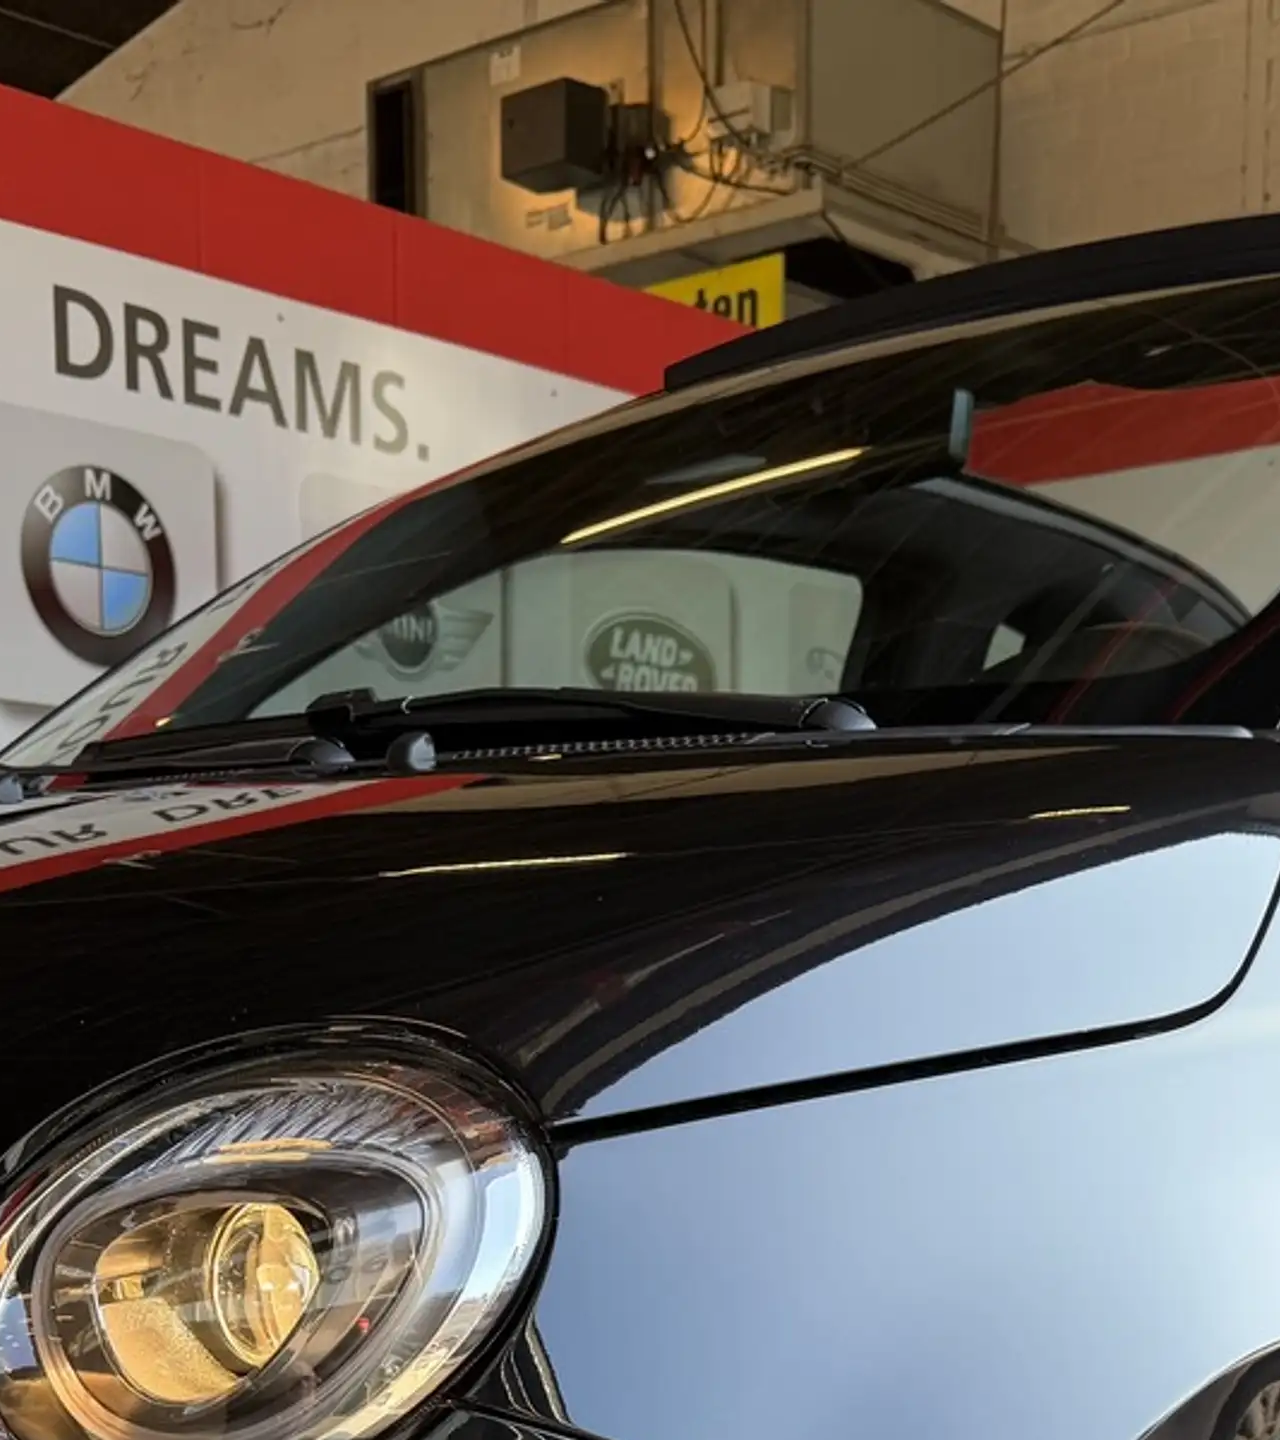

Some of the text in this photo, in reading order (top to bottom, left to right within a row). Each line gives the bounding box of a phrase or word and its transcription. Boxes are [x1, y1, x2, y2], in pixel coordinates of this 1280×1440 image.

[51, 283, 431, 461] DREAMS.
[34, 468, 162, 542] BMW
[609, 626, 678, 667] LAND
